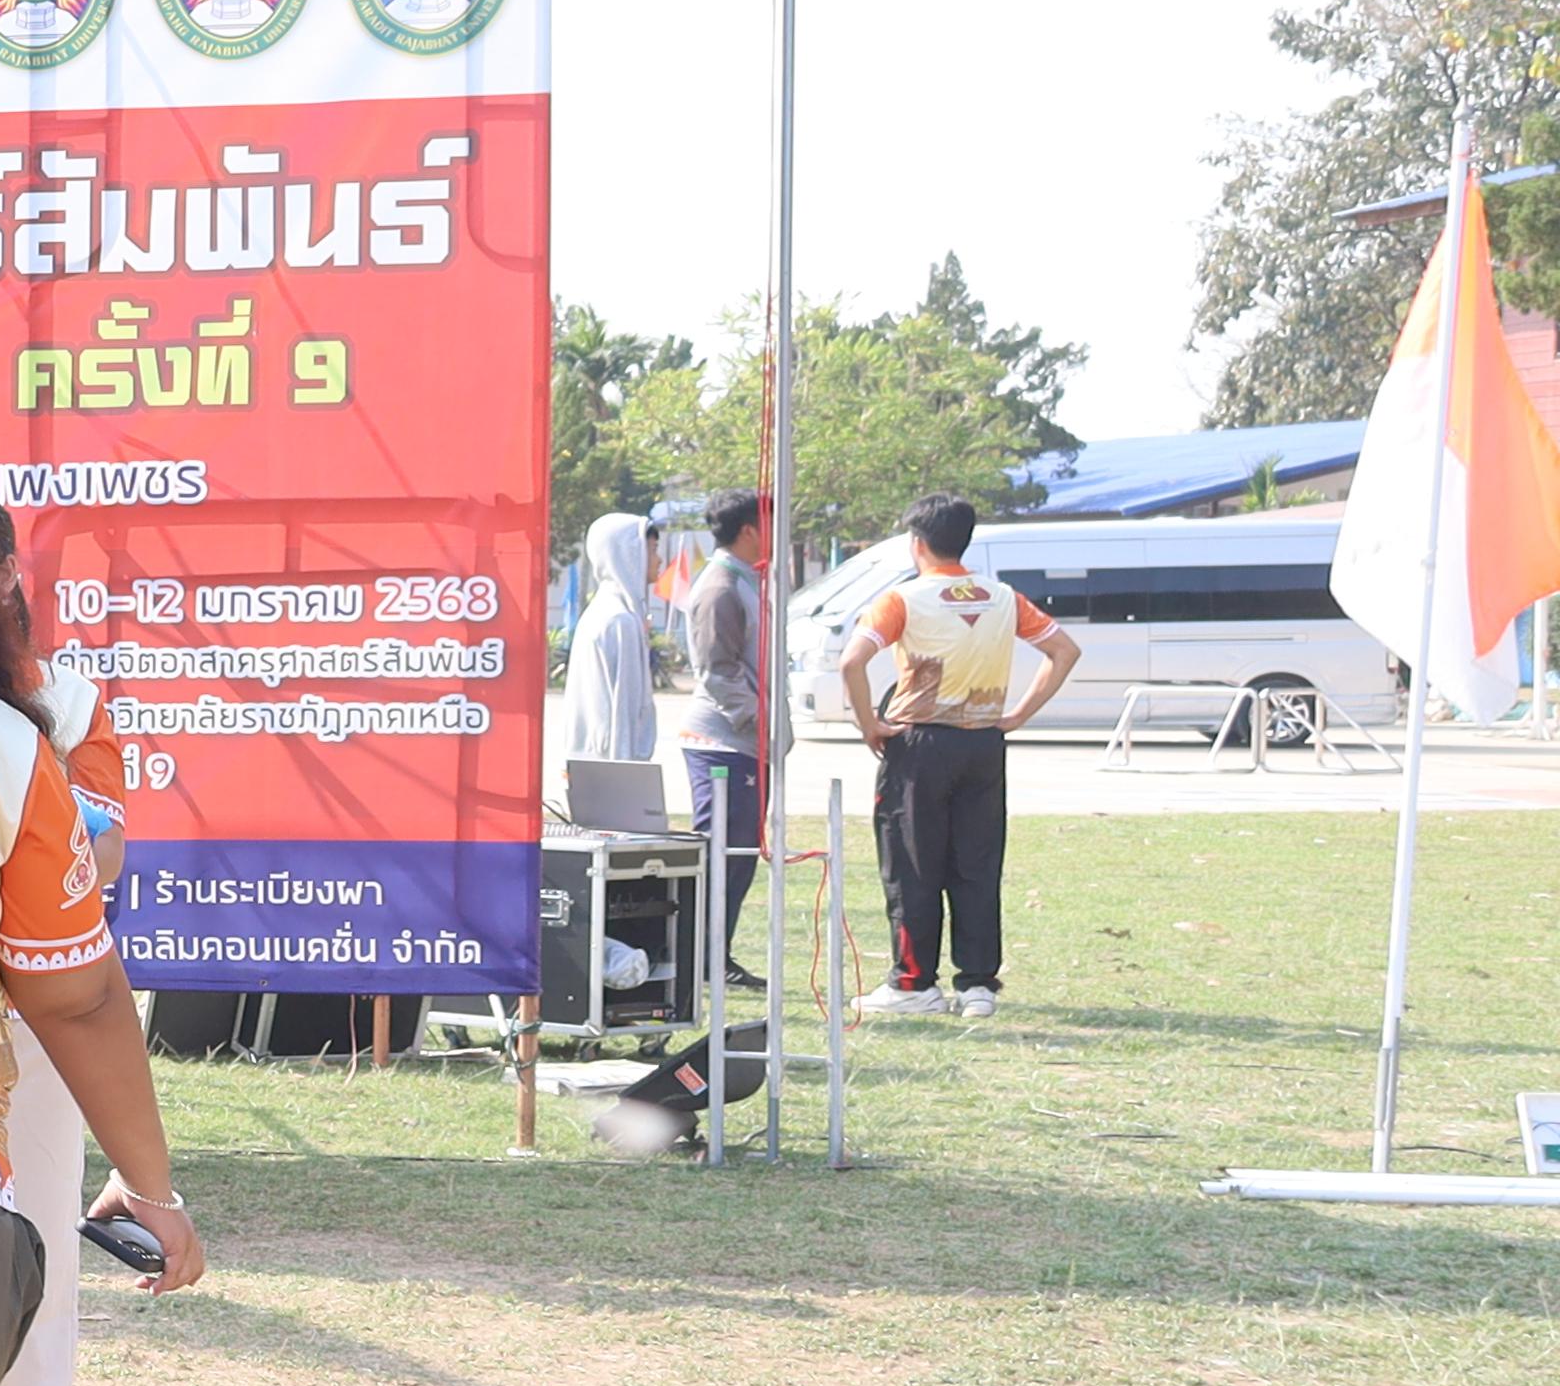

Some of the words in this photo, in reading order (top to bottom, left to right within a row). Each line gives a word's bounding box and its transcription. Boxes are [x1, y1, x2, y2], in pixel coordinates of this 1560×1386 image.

[190, 34, 261, 56] RAJABHAT
[394, 32, 458, 51] RAJABHAT
[17, 299, 253, 409] ครั้งที่
[56, 581, 183, 619] 10-12
[199, 585, 362, 619] มกราคม
[376, 580, 497, 619] 2568
[107, 697, 485, 738] าวิทยาลัยราชภัฏภาคเหนือ
[156, 870, 383, 906] ร้านระเบียงผา
[393, 930, 482, 965] จำกัด
